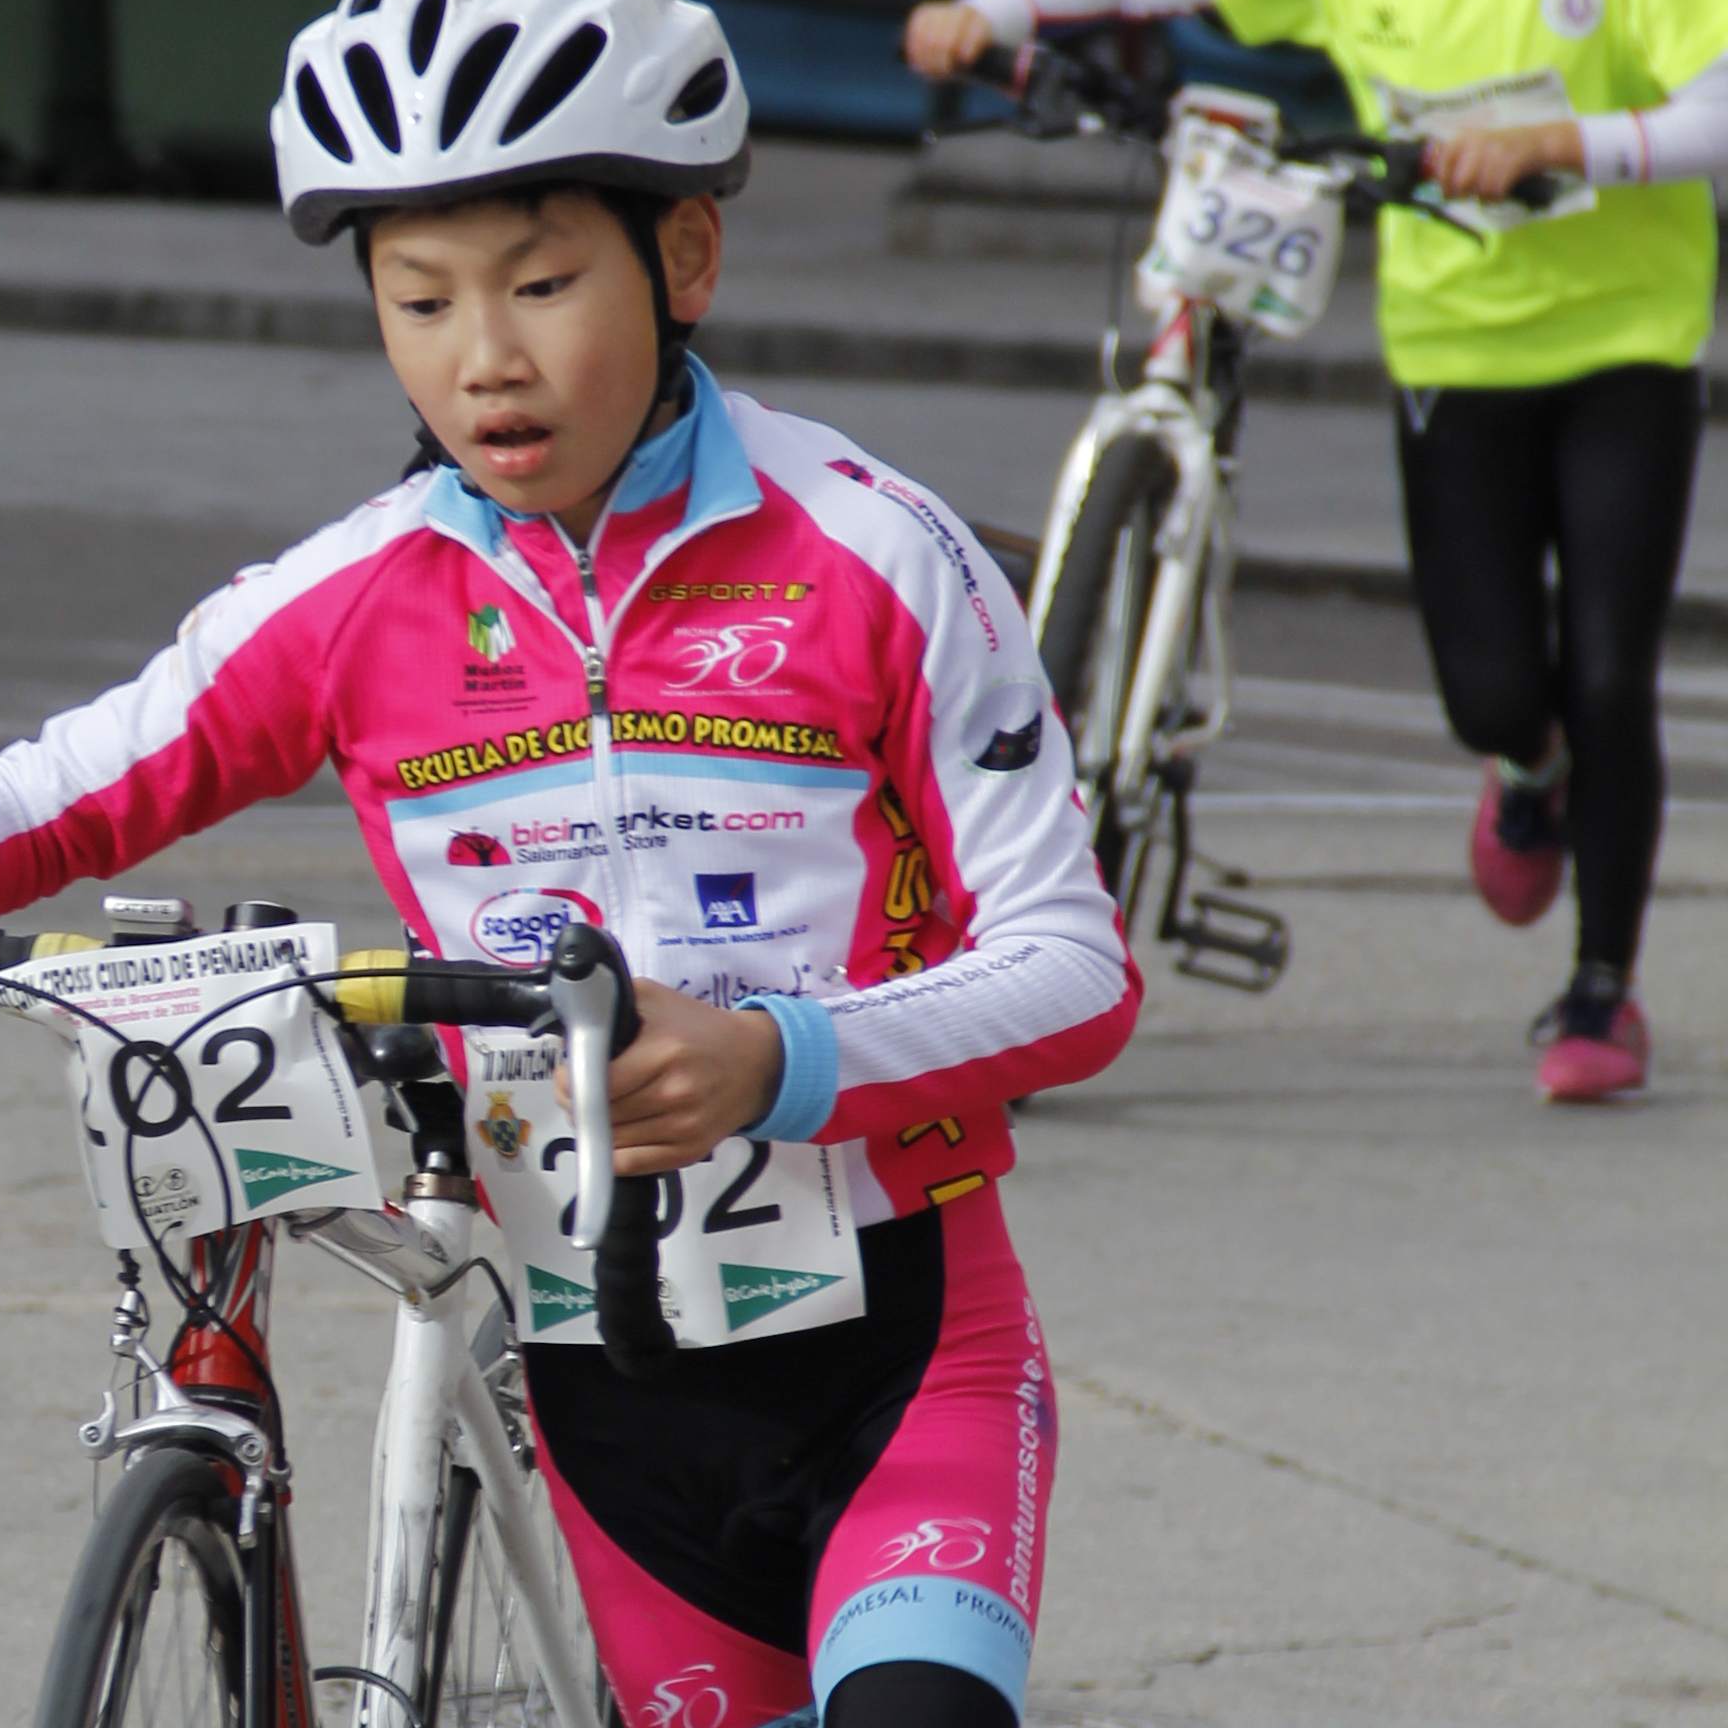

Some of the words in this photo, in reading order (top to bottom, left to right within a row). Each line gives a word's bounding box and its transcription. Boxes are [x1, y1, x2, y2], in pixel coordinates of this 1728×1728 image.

[1188, 190, 1323, 278] 326
[648, 581, 779, 601] GSPORT
[397, 741, 506, 789] ESCUELA
[504, 728, 545, 762] DE
[693, 714, 845, 760] PROMESAL
[112, 902, 171, 916] CATEYE
[706, 898, 750, 924] AXA
[40, 965, 94, 997] CROSS
[96, 960, 164, 991] CIUDAD
[171, 952, 196, 981] DE
